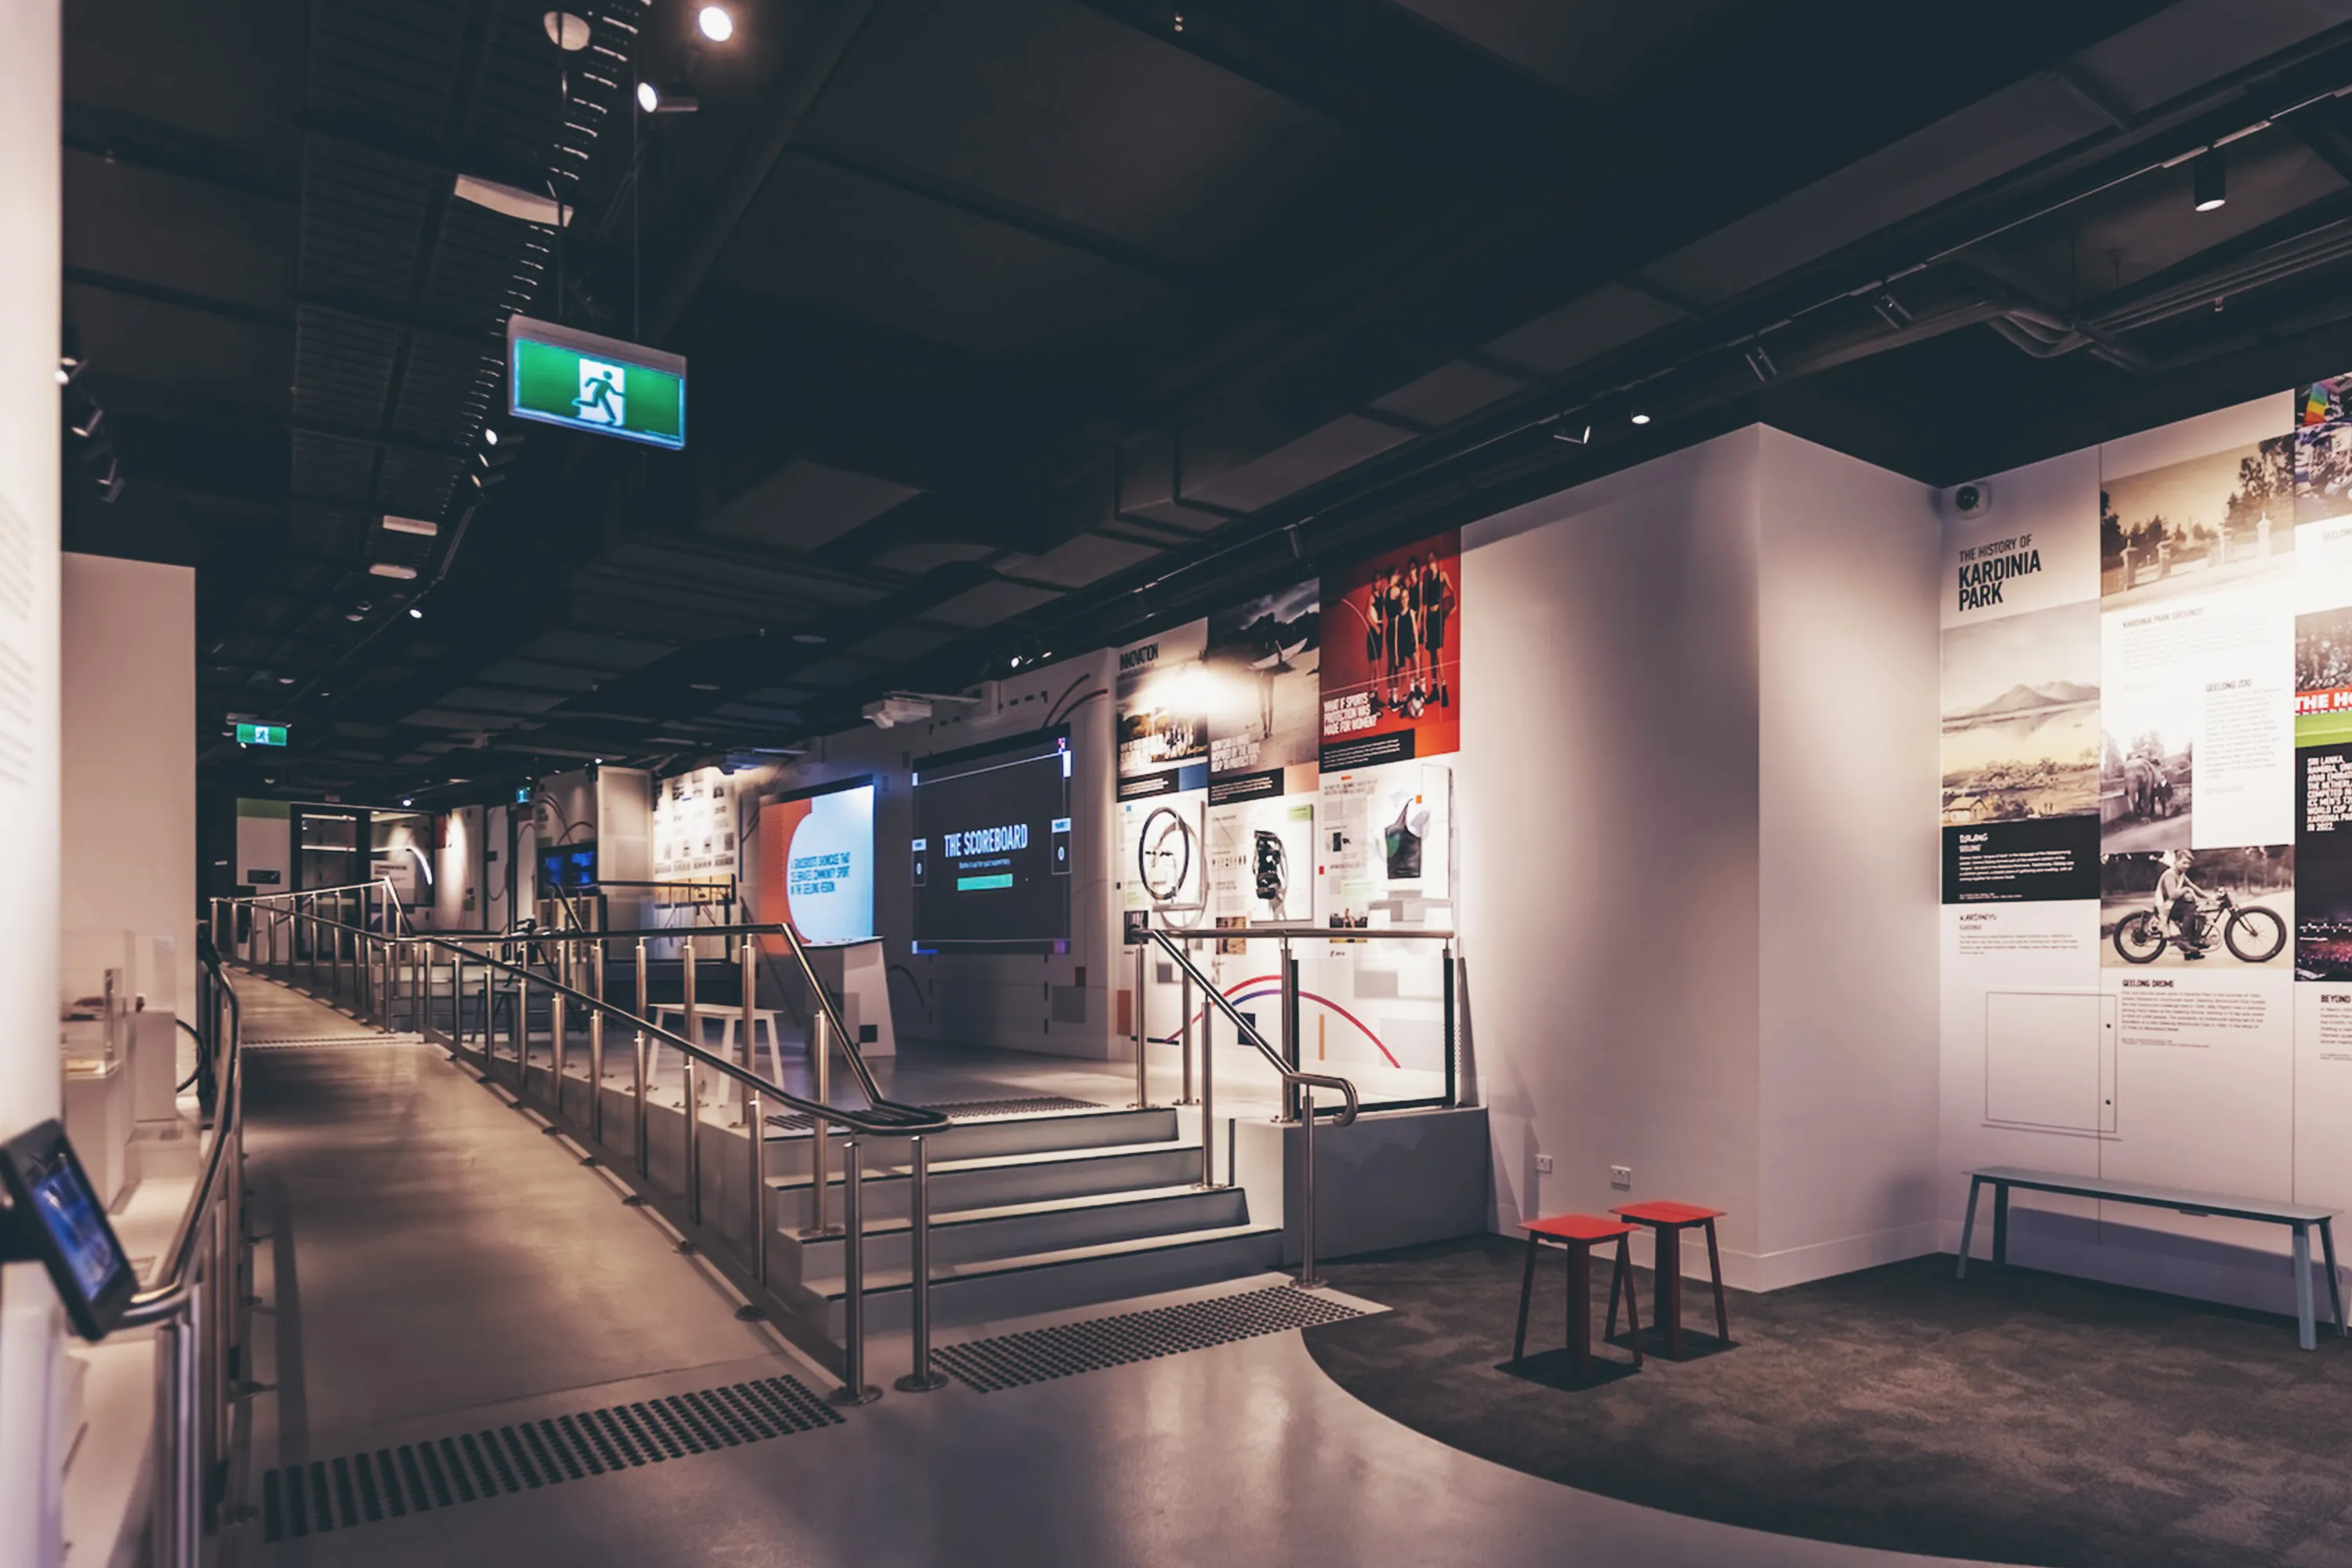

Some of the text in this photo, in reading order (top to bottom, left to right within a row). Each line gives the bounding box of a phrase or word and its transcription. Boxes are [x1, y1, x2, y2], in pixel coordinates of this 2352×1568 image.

[1959, 533, 2032, 563] THE HISTORY OF
[1959, 549, 2042, 589] KARDINIA
[1959, 581, 2003, 612] PARK
[2295, 695, 2328, 710] THE
[944, 823, 1028, 858] THE SCOREBOARD
[1058, 846, 1065, 861] 0
[2321, 994, 2351, 1004] BEYOND
